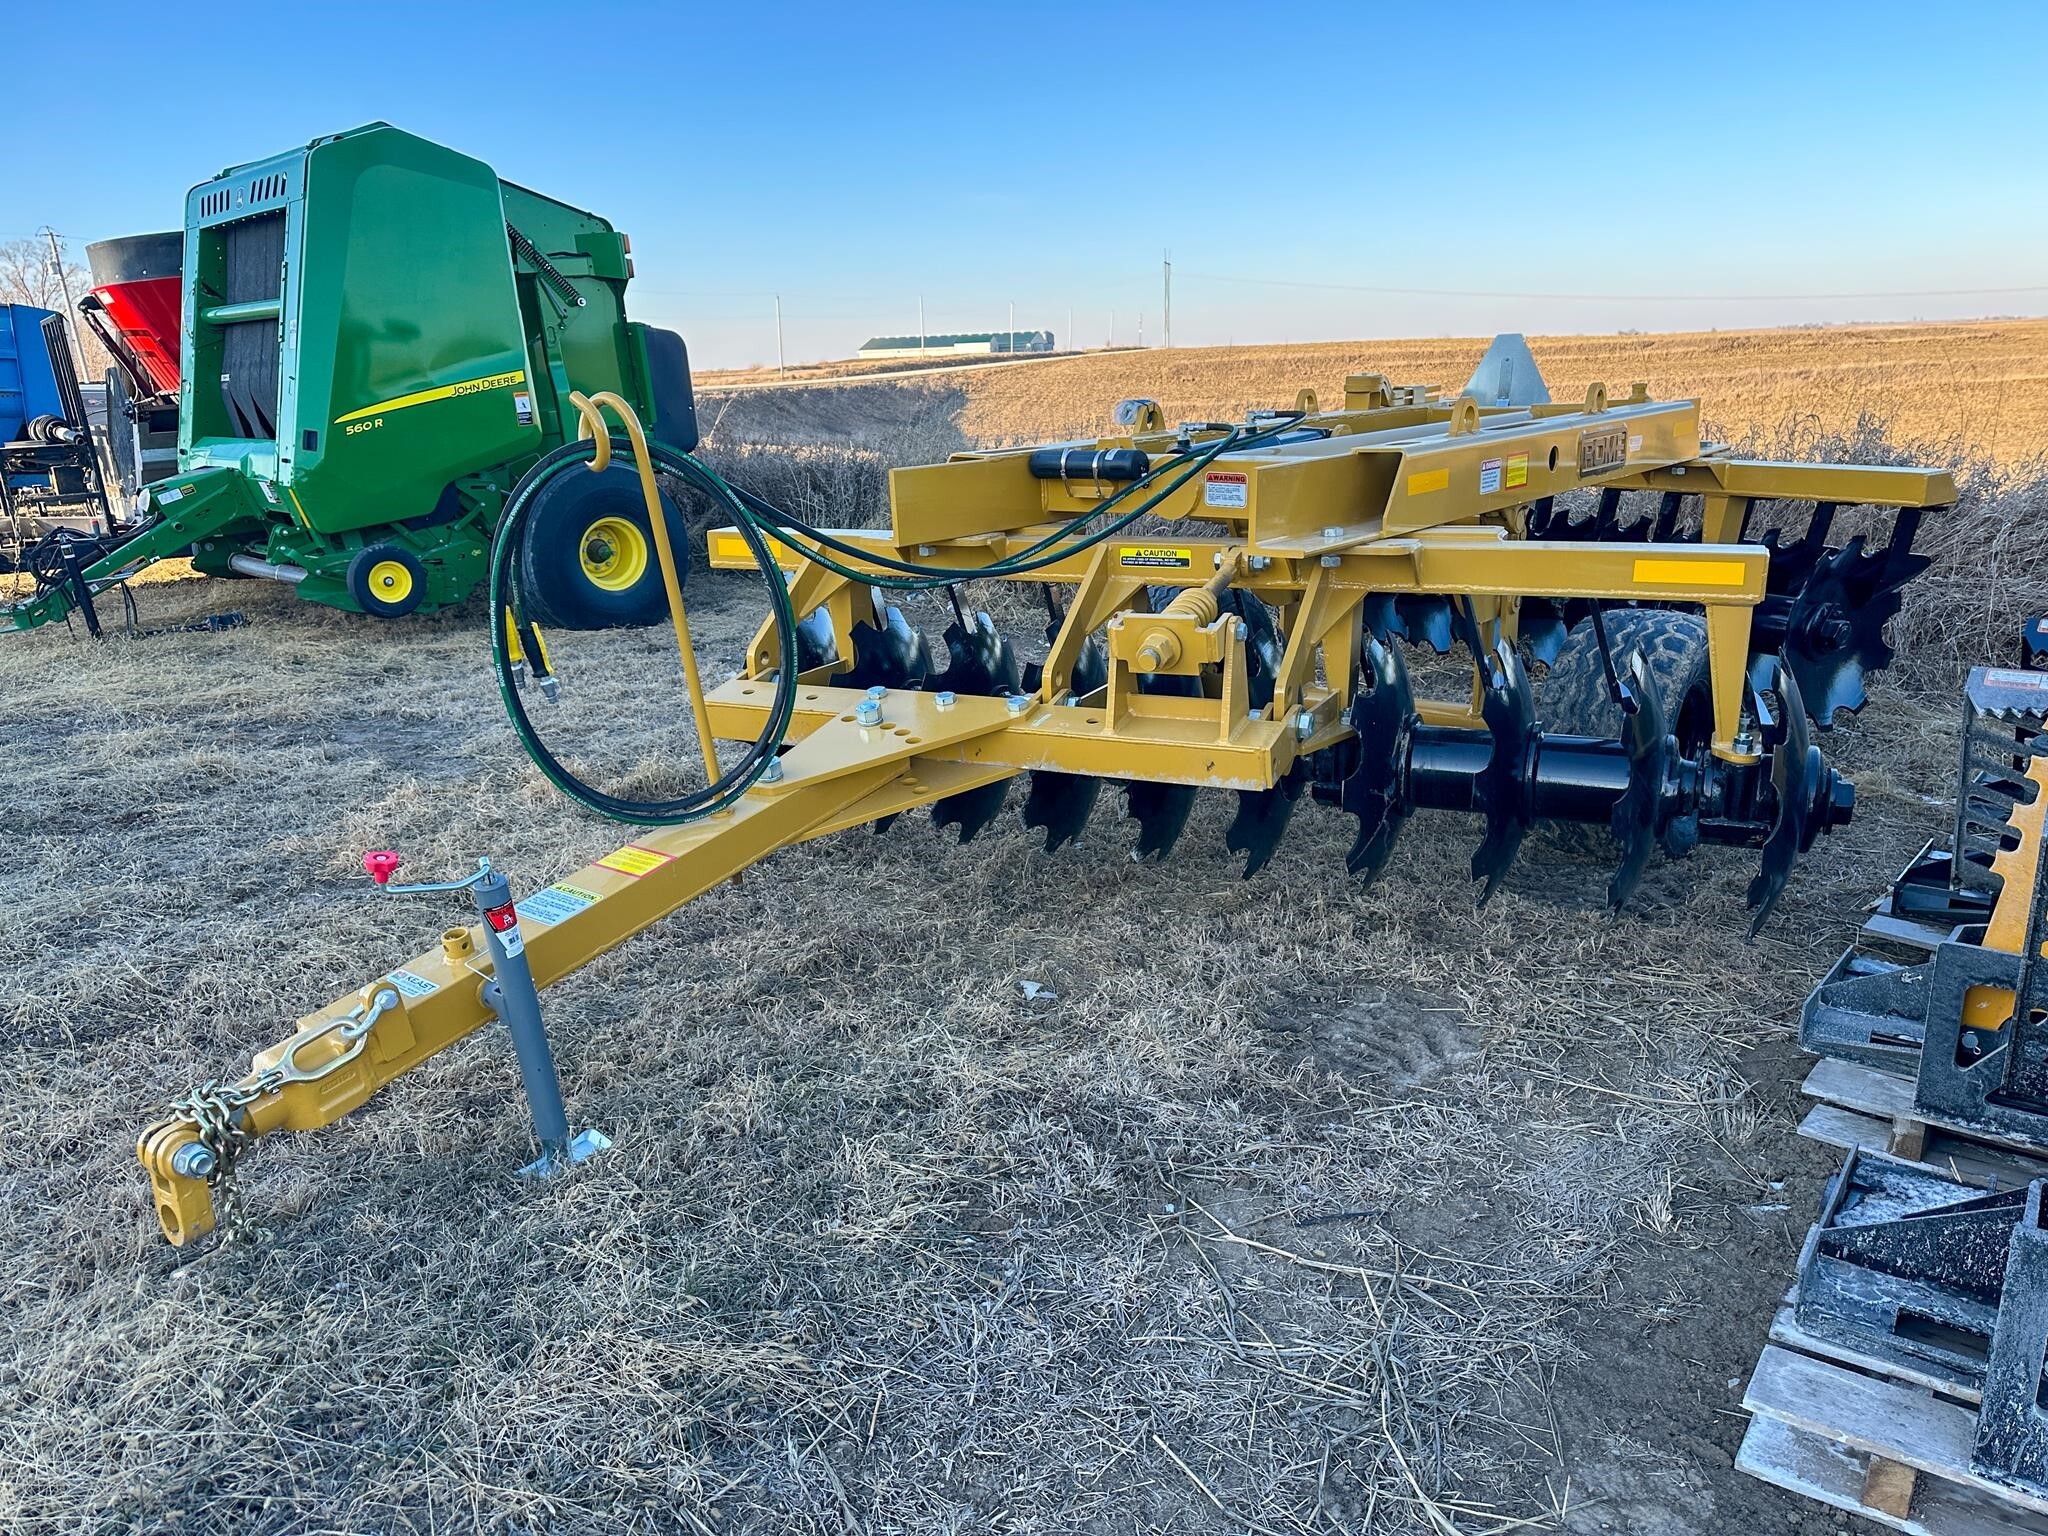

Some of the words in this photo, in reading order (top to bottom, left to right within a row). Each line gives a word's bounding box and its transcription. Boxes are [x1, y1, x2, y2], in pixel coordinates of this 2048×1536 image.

[451, 382, 480, 396] JOHN
[482, 376, 516, 390] DEERE
[346, 422, 372, 435] 560
[375, 418, 383, 428] R
[1582, 432, 1626, 469] ROME
[1213, 474, 1245, 483] WARNING
[1143, 549, 1177, 557] CAUTION
[490, 600, 498, 648] Weatherhead
[683, 803, 727, 823] Weatherhead
